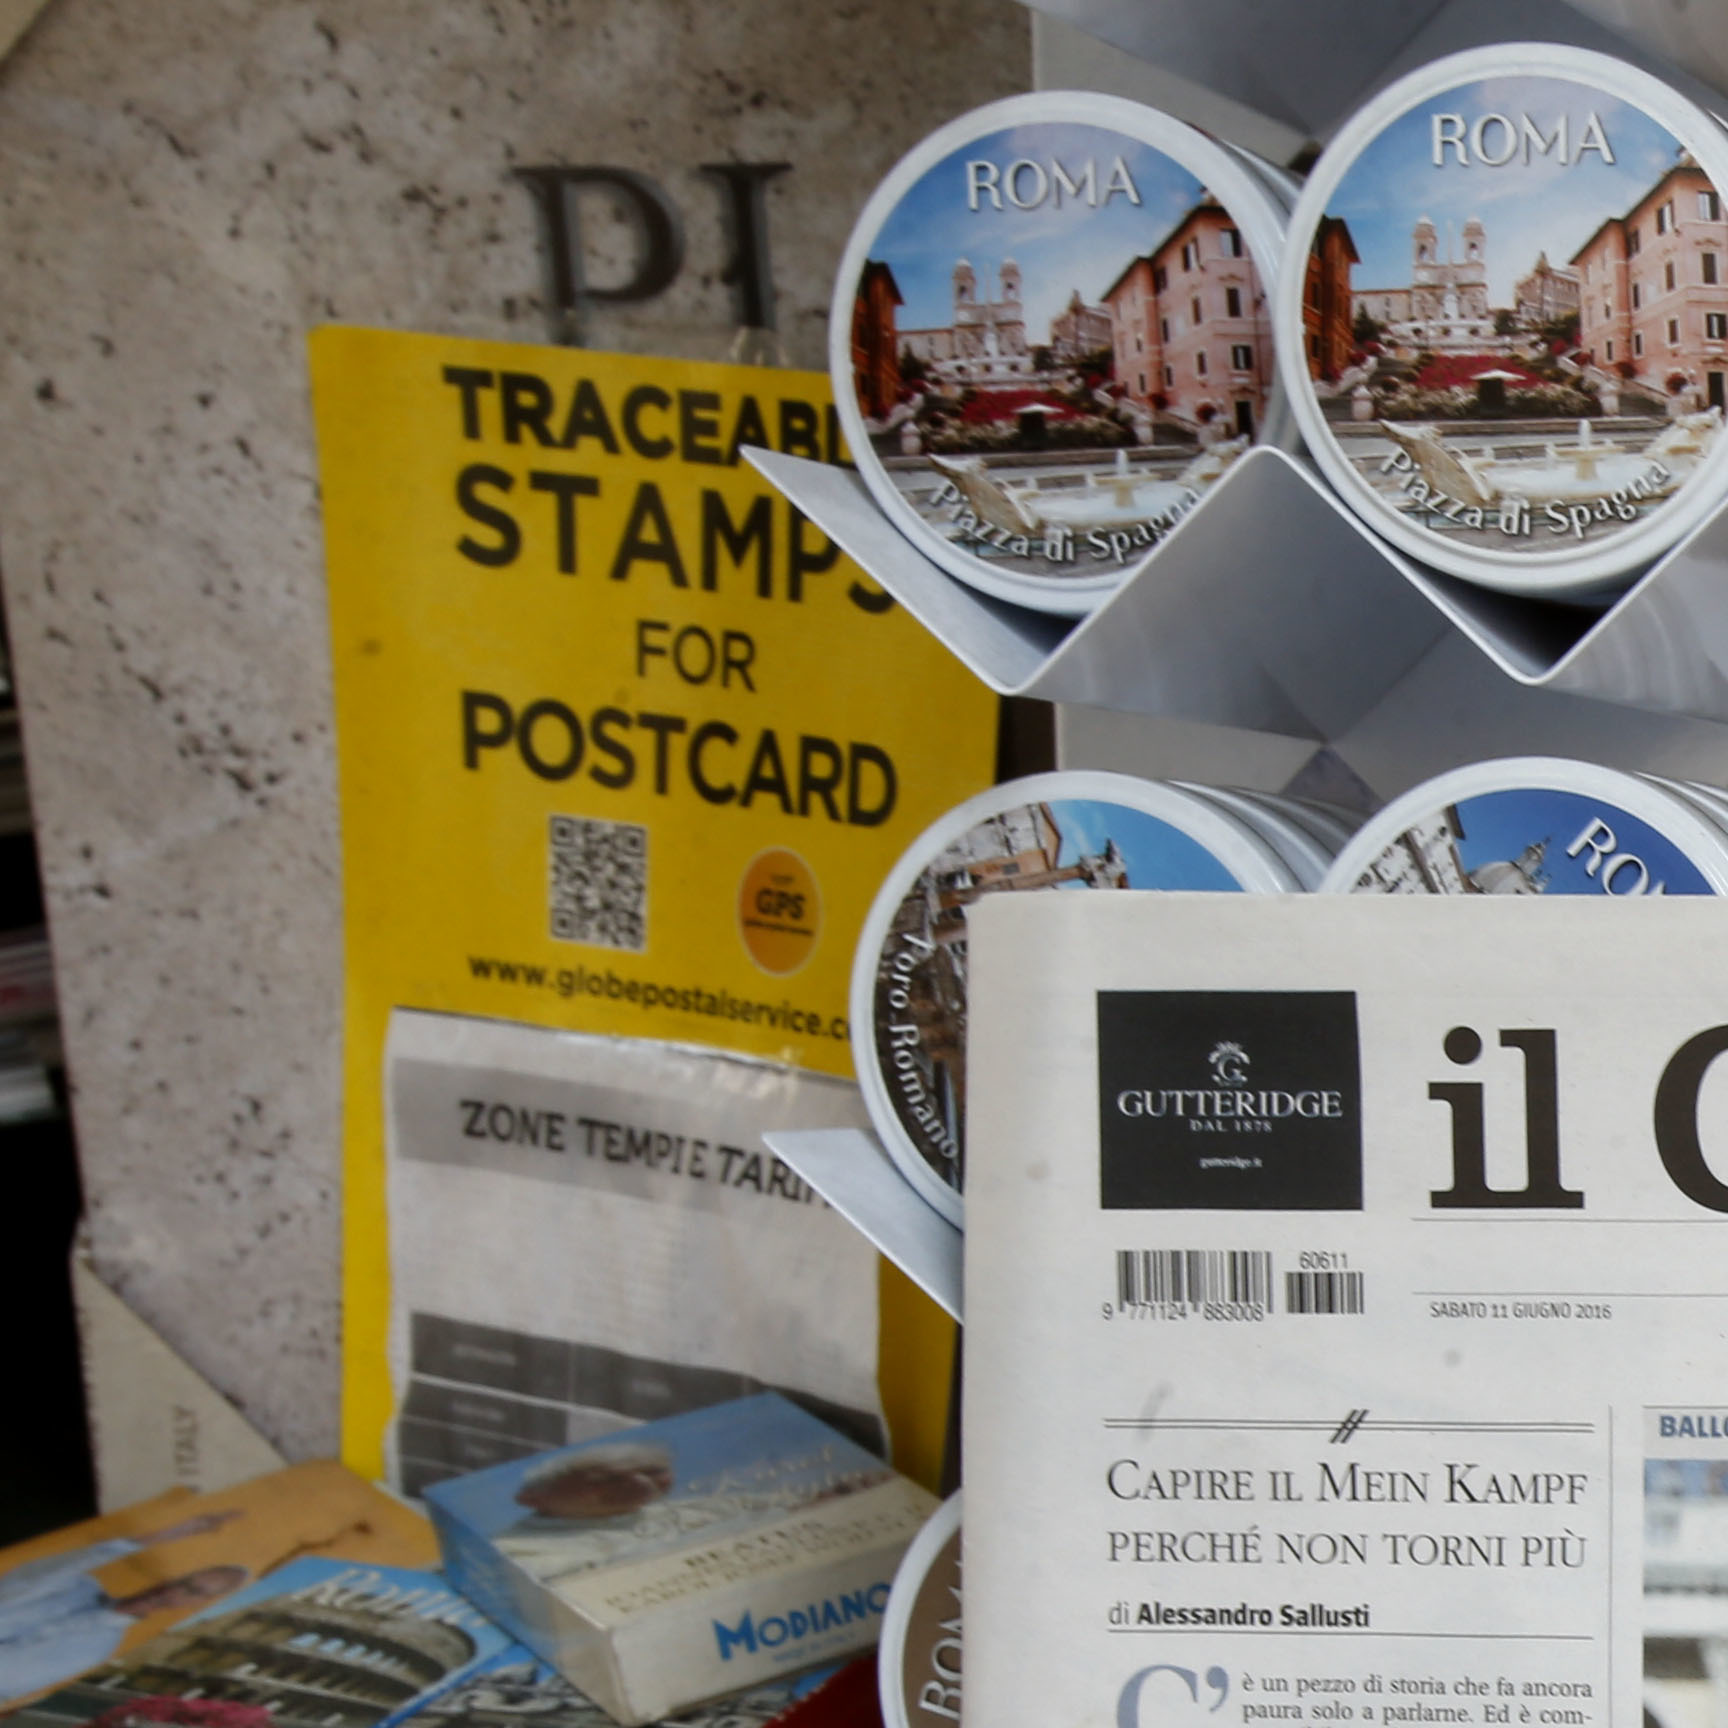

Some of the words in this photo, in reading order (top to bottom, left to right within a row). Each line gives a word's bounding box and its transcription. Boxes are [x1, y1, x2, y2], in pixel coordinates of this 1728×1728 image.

[1430, 111, 1615, 169] ROMA
[966, 156, 1141, 211] ROMA
[929, 479, 1032, 558] Piazza
[1044, 527, 1076, 562] di
[1380, 448, 1484, 530] Piazza
[1498, 499, 1532, 535] di
[1544, 459, 1671, 538] Spagna
[635, 618, 757, 693] FOR
[460, 690, 898, 828] POSTCARD
[459, 1099, 567, 1153] ZONE
[889, 1023, 959, 1160] Romano
[1117, 1089, 1344, 1119] GUTTERIDGE
[1190, 1119, 1227, 1133] DAL
[1233, 1119, 1273, 1133] 1878
[1427, 1024, 1586, 1210] il
[1429, 1301, 1488, 1320] SABATO
[1491, 1303, 1509, 1320] 11
[1512, 1303, 1571, 1320] GIUGNO
[1574, 1303, 1613, 1321] 2016
[711, 1582, 893, 1662] MODIANO
